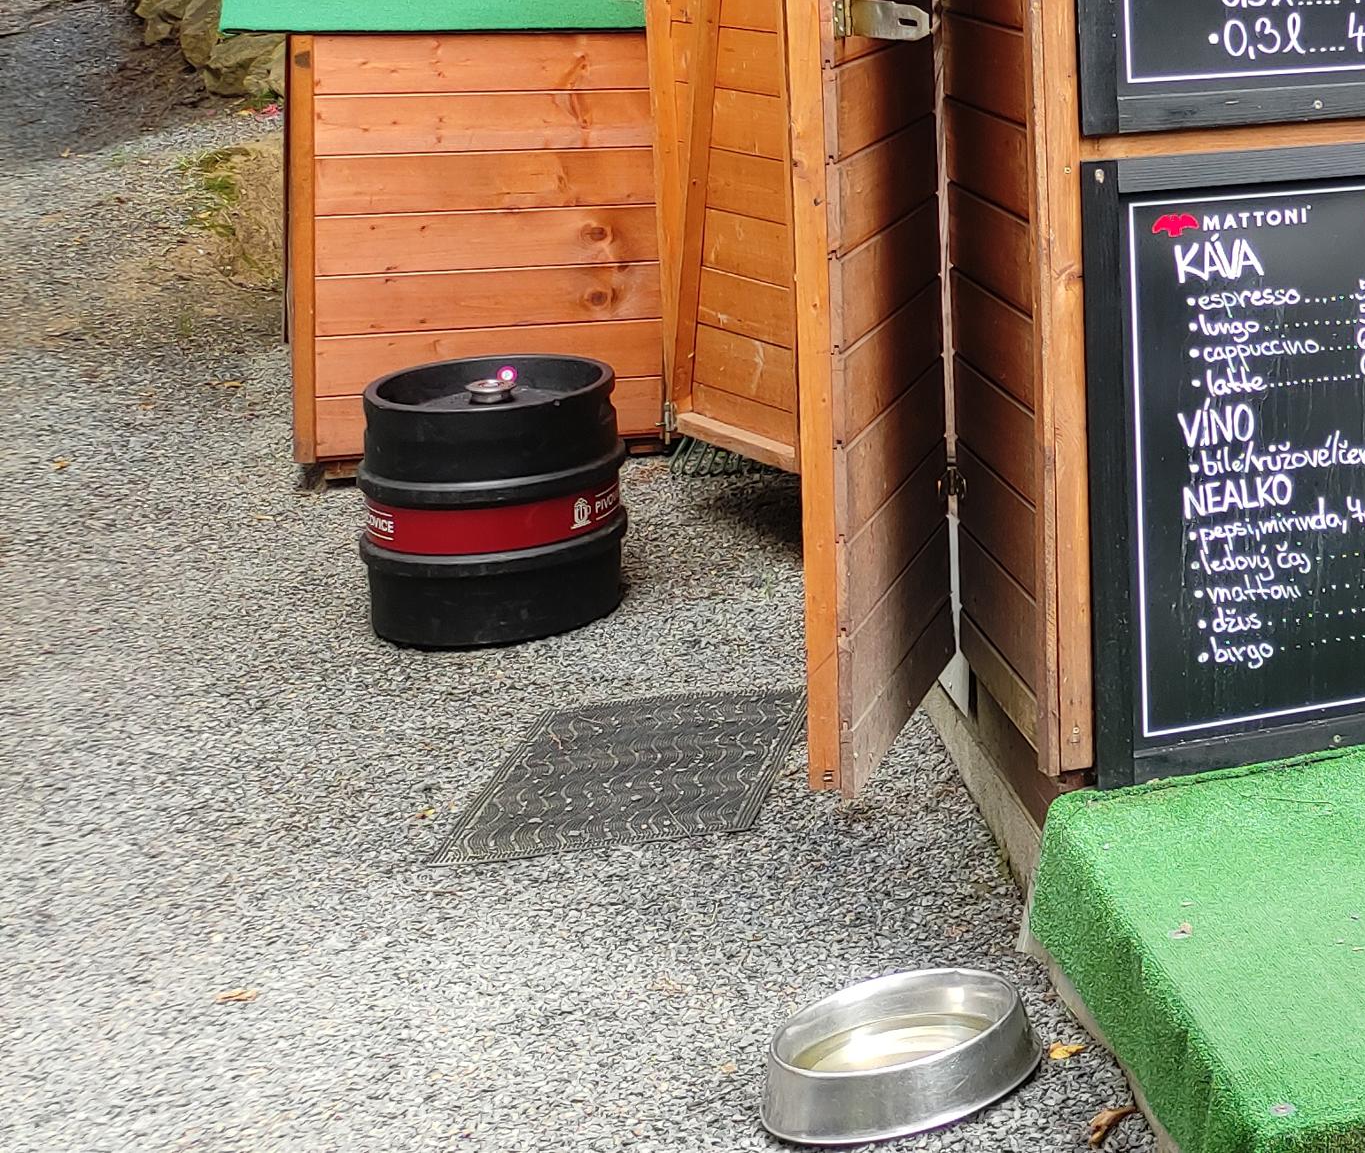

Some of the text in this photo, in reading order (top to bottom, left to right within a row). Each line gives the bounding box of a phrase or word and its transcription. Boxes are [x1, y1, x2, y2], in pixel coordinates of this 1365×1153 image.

[1203, 207, 1308, 231] MATTONI
[1174, 234, 1264, 283] KÁVA
[1198, 287, 1300, 318] espresso
[1199, 314, 1260, 343] lungo
[1203, 334, 1319, 372] cappuccino
[1206, 369, 1267, 398] latte
[1177, 398, 1254, 447] VÍNO
[1182, 473, 1292, 519] NEALKO
[1200, 544, 1274, 581] ledový
[1276, 541, 1311, 573] čaj
[1207, 574, 1301, 604] mattoni
[1212, 607, 1262, 633] džus
[1210, 636, 1274, 669] birgo
